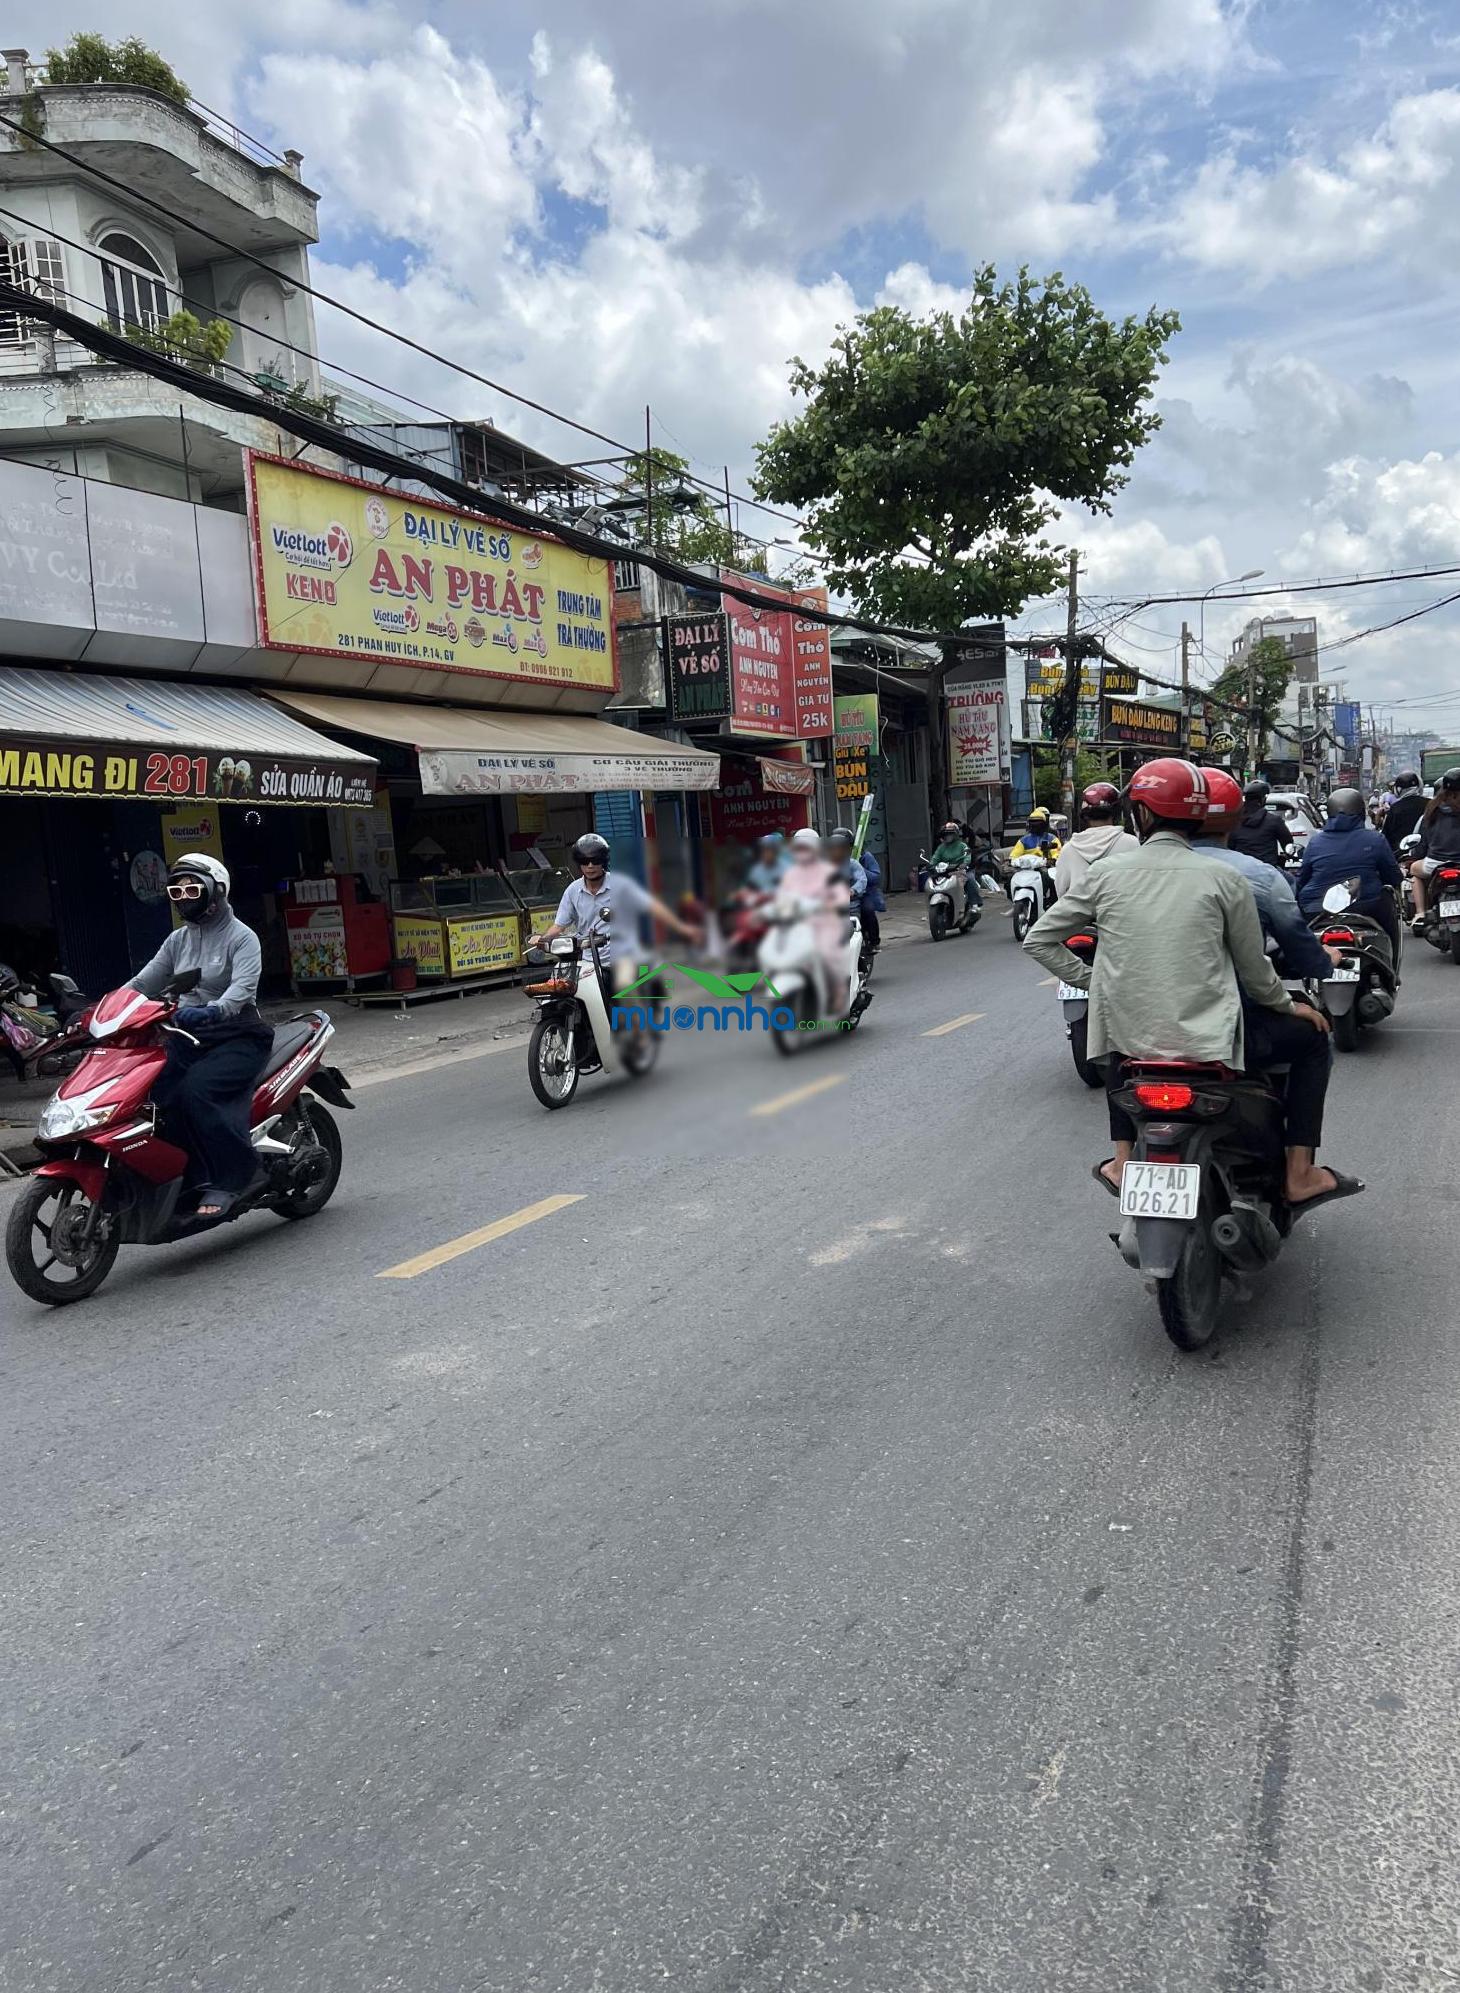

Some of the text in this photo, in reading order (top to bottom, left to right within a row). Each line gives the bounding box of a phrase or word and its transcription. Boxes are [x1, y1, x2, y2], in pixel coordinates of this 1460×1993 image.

[272, 527, 328, 557] Vietlott
[403, 511, 437, 549] ĐẠI
[441, 518, 460, 548] LÝ
[463, 526, 486, 554] VÉ
[488, 532, 512, 561] SỐ
[285, 572, 337, 604] KENO
[369, 548, 545, 625] AN PHÁT
[557, 590, 585, 616] TRUNG
[373, 608, 405, 625] Vietlott
[426, 621, 447, 634] Mega
[674, 618, 720, 650] ĐẠI LÝ
[731, 617, 783, 656] Cơm Thố
[338, 633, 355, 648] 281
[357, 636, 383, 652] PHAN
[384, 640, 402, 655] HUY
[443, 649, 455, 661] GV
[797, 638, 826, 655] Thố
[678, 645, 720, 675] VÉ SỐ
[739, 655, 754, 675] ANH
[804, 661, 821, 672] ANH
[560, 667, 574, 679] 912
[1105, 670, 1119, 689] BÚN
[802, 711, 829, 729] 25k
[1111, 702, 1128, 725] BÚN
[0, 750, 208, 795] MANG ĐI 281
[455, 770, 580, 792] AN PHÁT
[835, 760, 867, 779] BÚN
[260, 764, 344, 799] SỬA QUẦN ÁO
[723, 801, 745, 815] ANH
[122, 1139, 149, 1153] HONDA
[1134, 1166, 1188, 1190] 71-AD
[1126, 1190, 1191, 1215] 026.21
